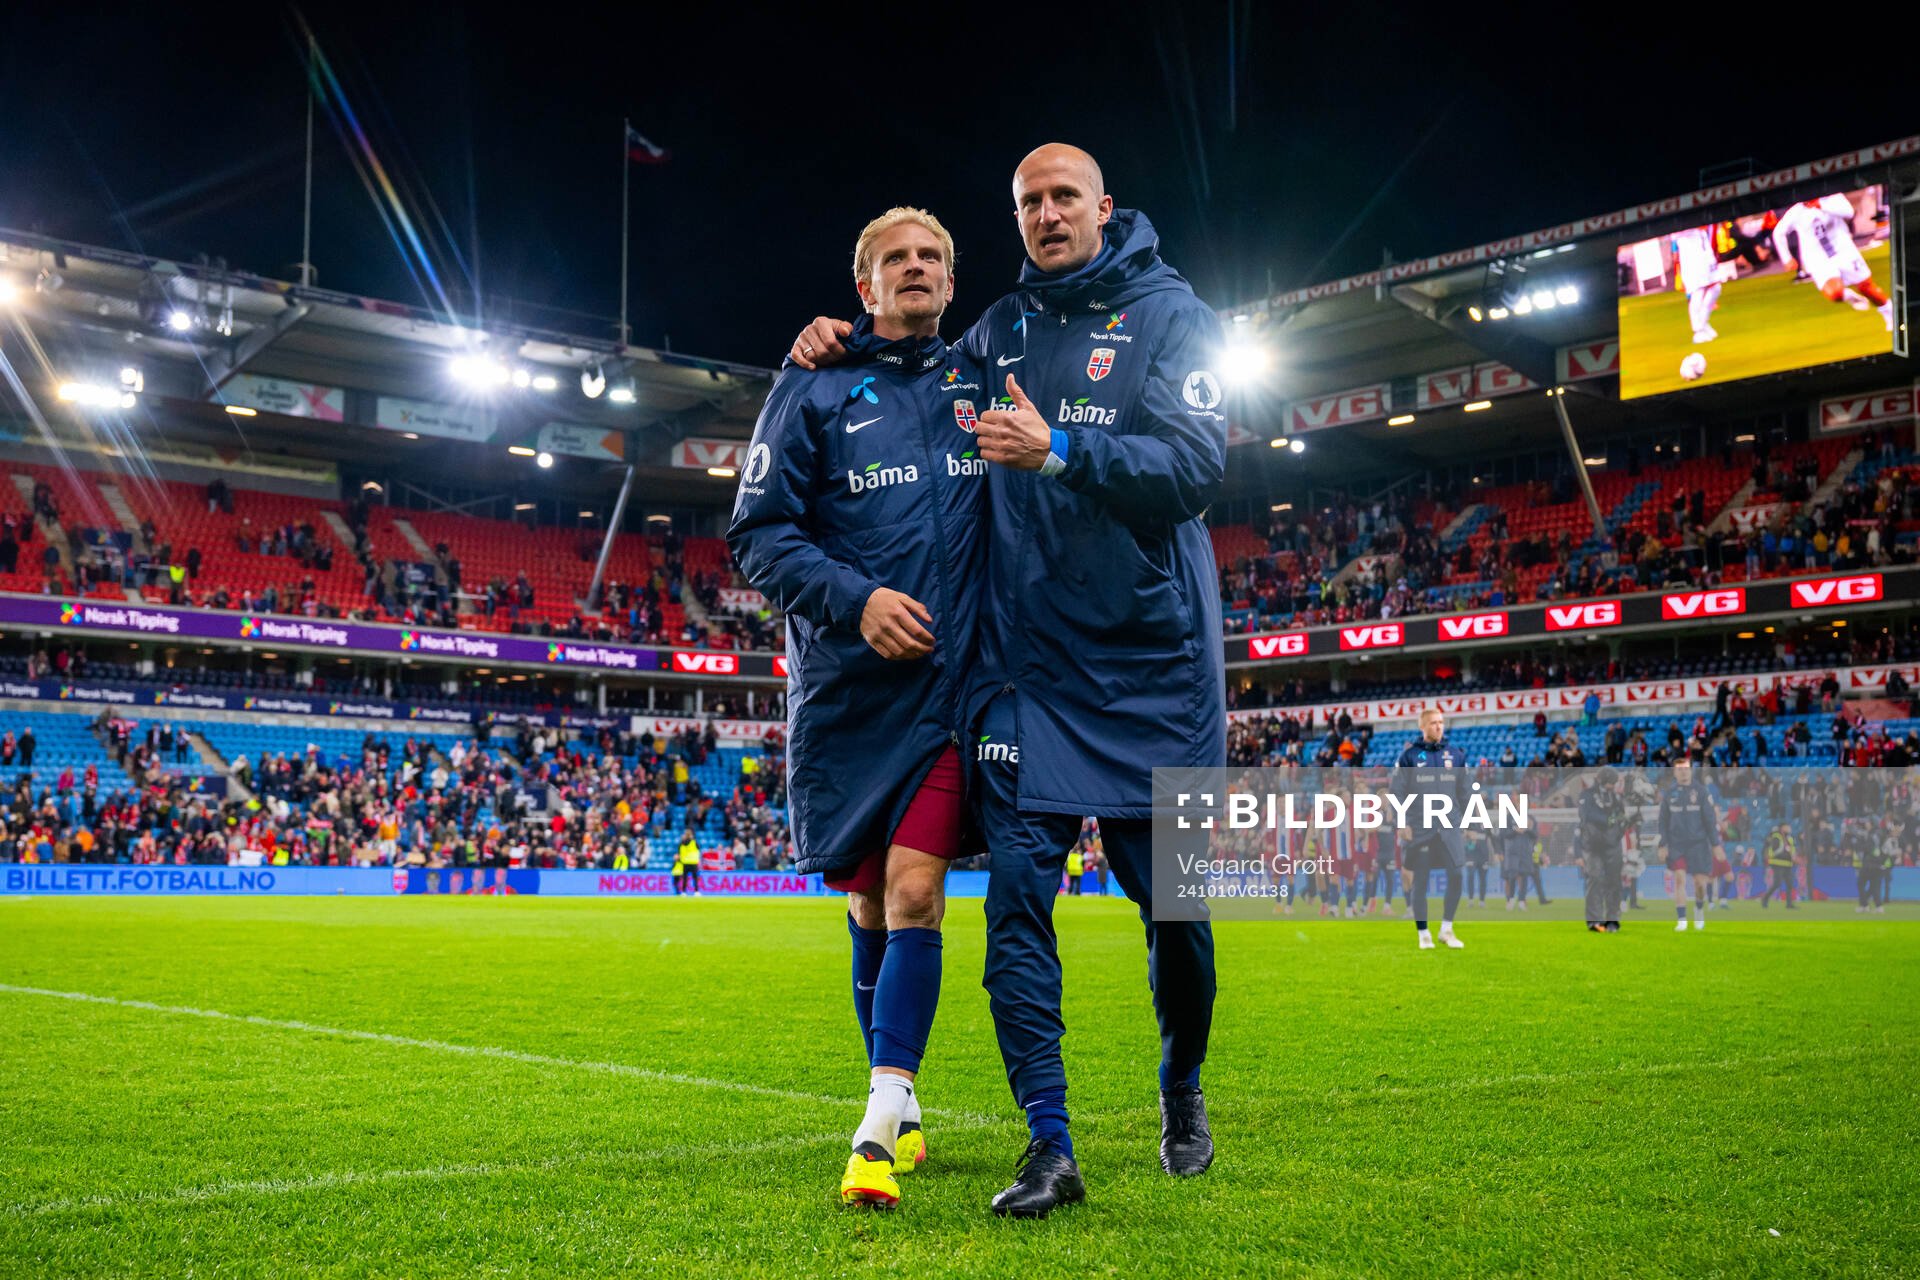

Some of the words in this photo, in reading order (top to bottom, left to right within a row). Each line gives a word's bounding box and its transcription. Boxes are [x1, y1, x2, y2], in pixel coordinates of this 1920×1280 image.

[1812, 152, 1858, 173] VG
[1751, 169, 1795, 191] VG
[1090, 332, 1108, 340] Norsk
[1109, 333, 1133, 343] Tipping
[1571, 343, 1619, 373] V
[1433, 366, 1522, 399] VG
[1058, 398, 1117, 425] bama
[1296, 391, 1377, 426] VG
[1826, 393, 1911, 422] VG
[688, 443, 744, 466] V
[946, 453, 989, 477] bam
[848, 463, 919, 493] bama
[1796, 577, 1876, 604] VG
[1549, 603, 1616, 627] VG
[1665, 591, 1739, 616] VG
[85, 608, 127, 625] Norsk
[127, 609, 180, 632] Tipping
[1442, 614, 1504, 637] VG
[262, 621, 300, 638] Norsk
[300, 622, 348, 645] Tipping
[1343, 625, 1400, 648] VG
[420, 635, 456, 651] Norsk
[456, 636, 498, 657] Tipping
[565, 647, 598, 663] Norsk
[598, 649, 637, 668] Tipping
[1252, 635, 1305, 657] VG
[675, 654, 734, 673] VG
[1438, 697, 1482, 713] VG
[1499, 693, 1546, 710] VG
[1629, 685, 1682, 702] VG
[1380, 702, 1424, 717] VG
[6, 869, 276, 891] BILLETT.FOTBALL.NO
[599, 875, 669, 892] NORGE
